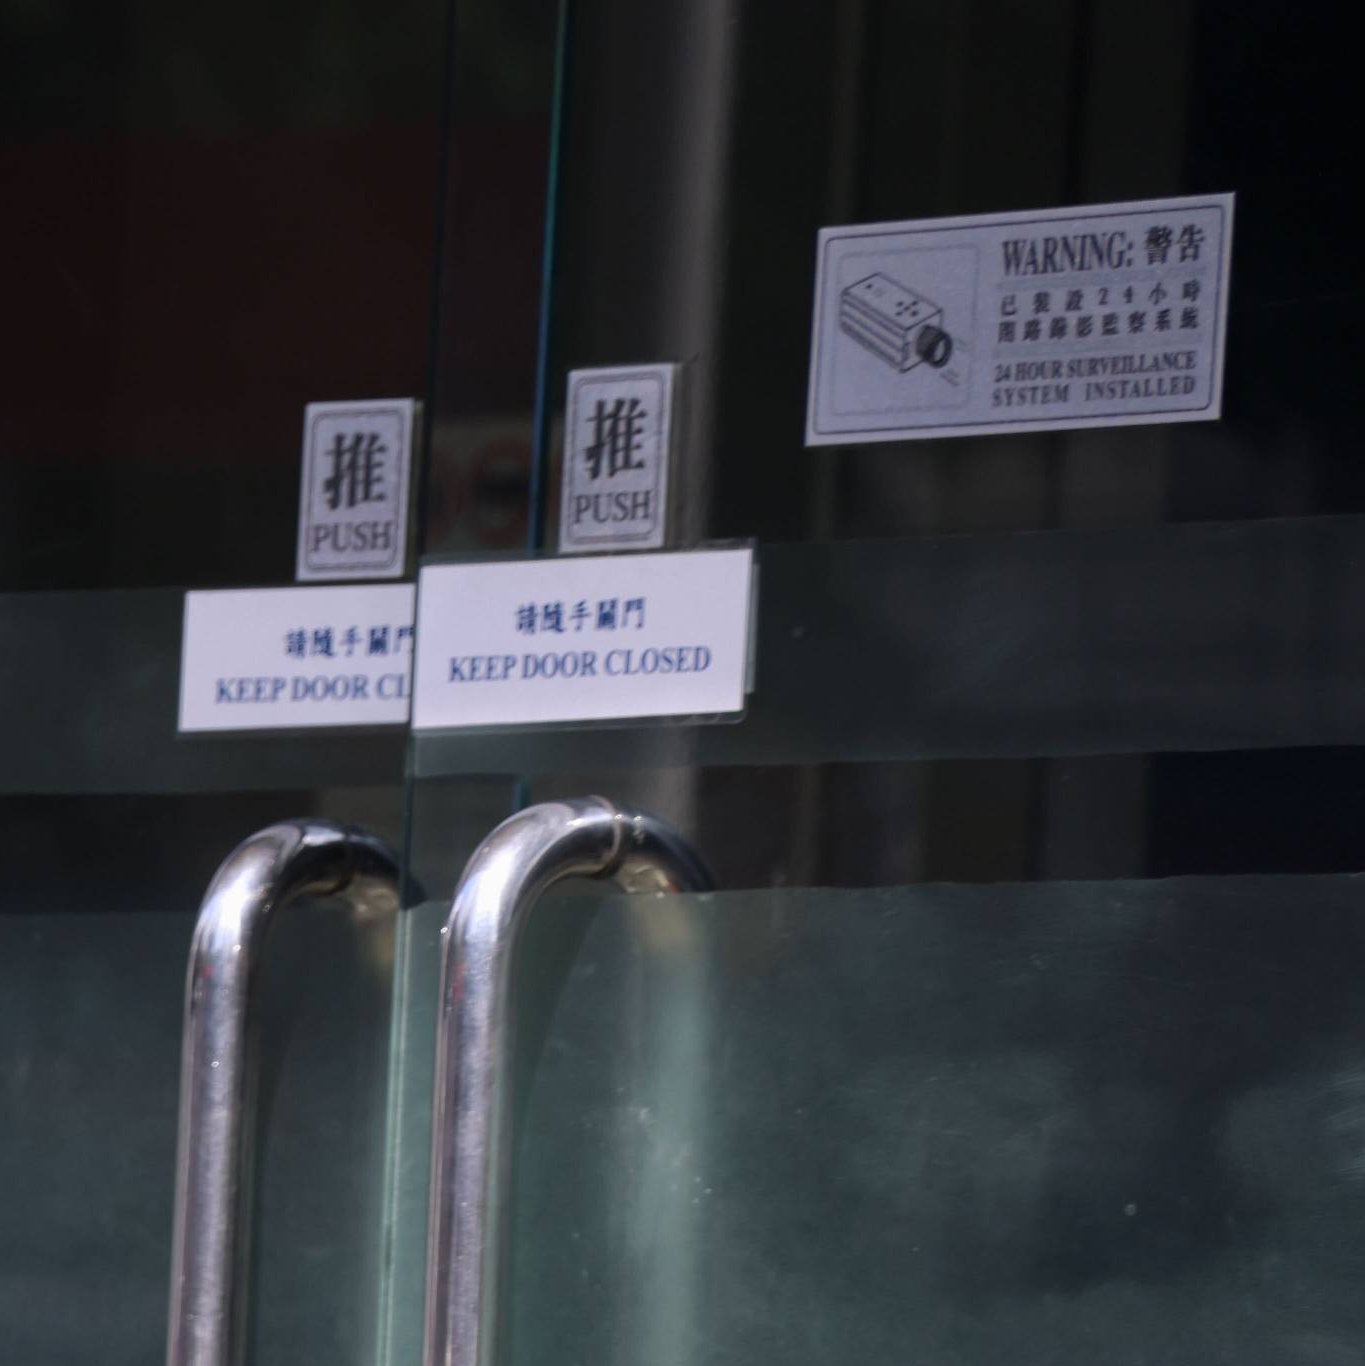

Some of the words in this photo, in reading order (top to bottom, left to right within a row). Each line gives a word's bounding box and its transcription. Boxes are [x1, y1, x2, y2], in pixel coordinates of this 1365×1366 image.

[1001, 231, 1134, 276] WARNING:
[1142, 223, 1205, 266] 警告
[994, 364, 1011, 383] 24
[1014, 360, 1063, 382] HOUR
[1066, 350, 1197, 379] SURVEILLANCE
[992, 384, 1070, 408] SYSTEM
[1084, 375, 1197, 402] INSTALLED
[584, 398, 648, 480] 推
[324, 432, 386, 511] 推
[571, 490, 653, 525] PUSH
[312, 519, 394, 552] PUSH
[515, 597, 646, 635] 請隨手關門
[448, 655, 517, 682] KEEP
[521, 651, 598, 679] DOOR
[604, 645, 712, 677] CLOSED
[215, 677, 286, 704] KEEP
[290, 674, 370, 701] DOOR
